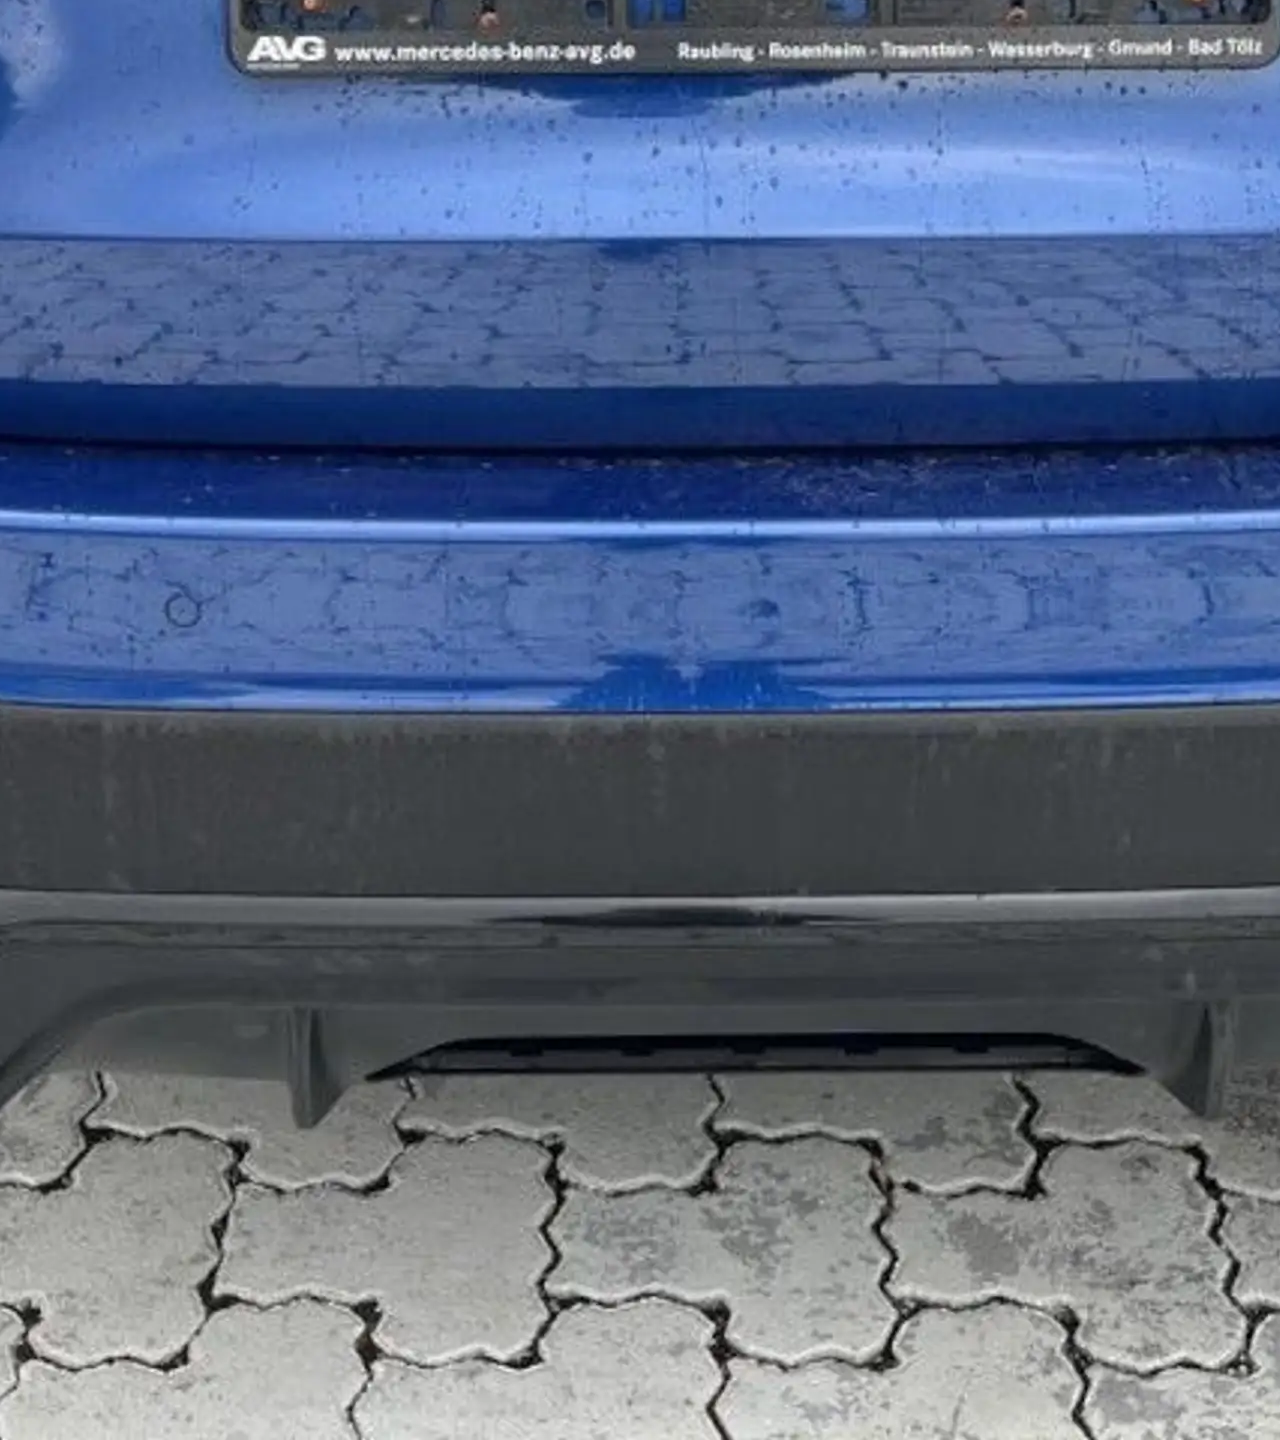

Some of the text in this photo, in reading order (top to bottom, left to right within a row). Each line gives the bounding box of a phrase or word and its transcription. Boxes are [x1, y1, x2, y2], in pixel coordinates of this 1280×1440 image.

[247, 35, 326, 62] AVG
[334, 40, 636, 65] www.mercedes-benz-avg.de
[677, 42, 755, 62] Raubling
[769, 41, 867, 60] Rosenheim
[880, 41, 973, 59] Traunstein
[988, 40, 1093, 60] Wasserburg
[1108, 38, 1173, 57] Gmund
[1188, 37, 1222, 56] Bad
[1225, 36, 1263, 56] Tölz
